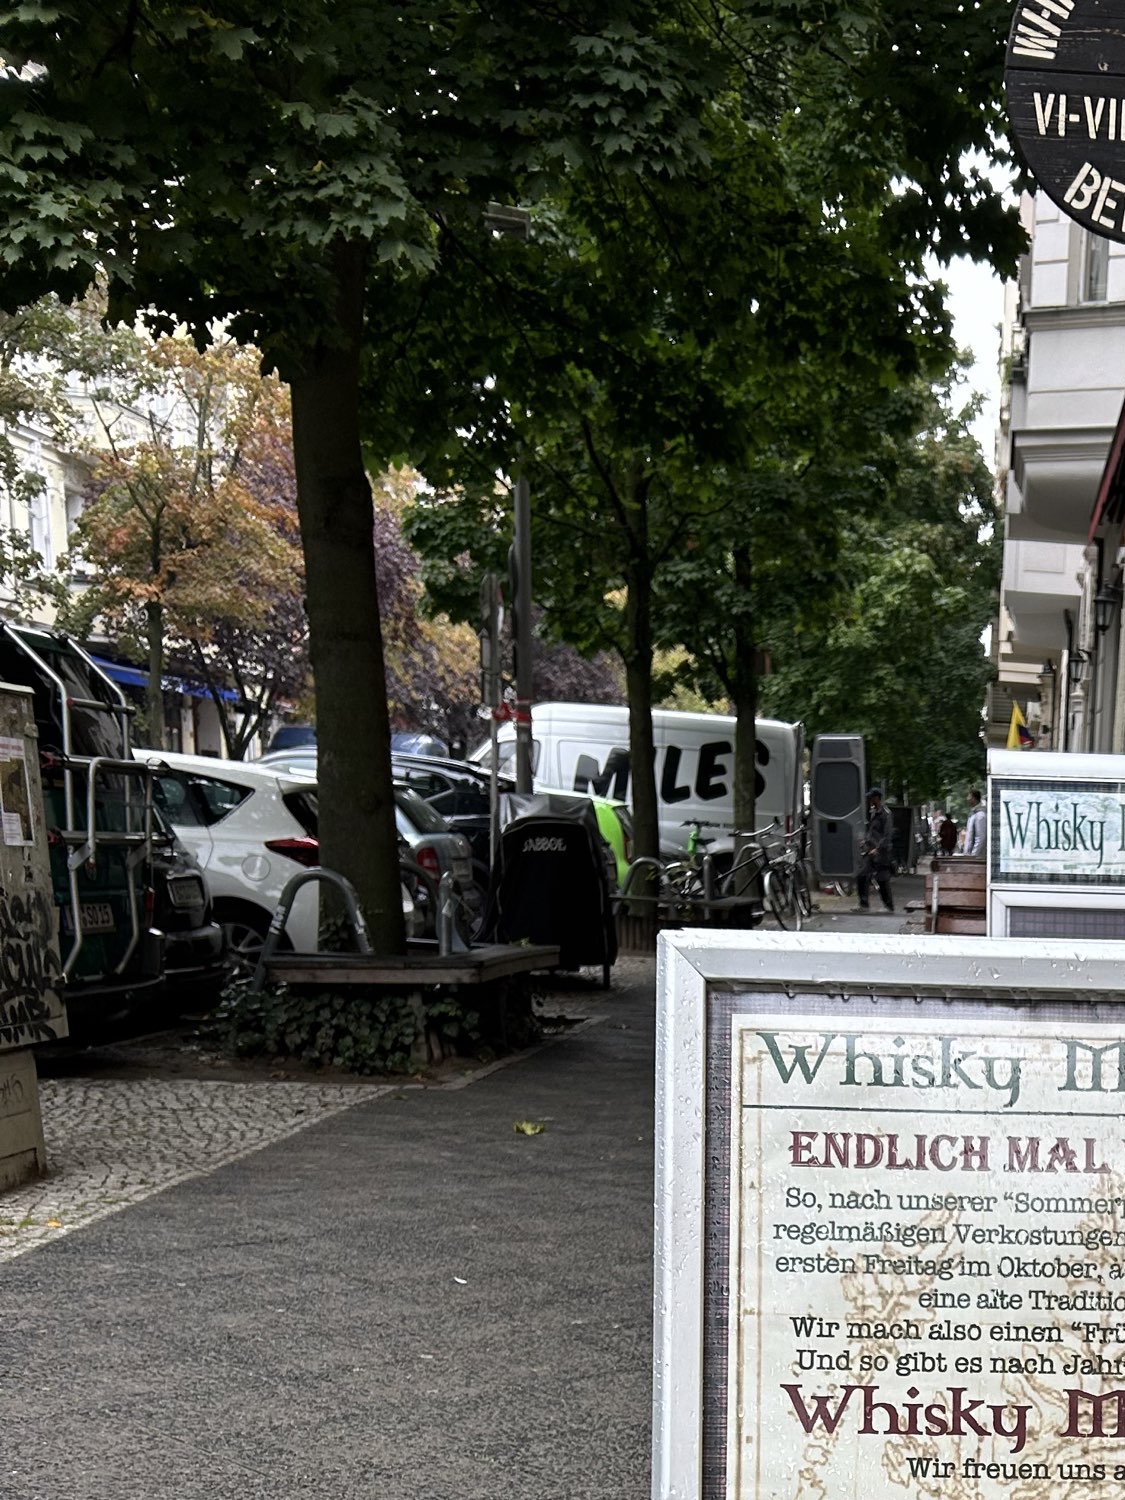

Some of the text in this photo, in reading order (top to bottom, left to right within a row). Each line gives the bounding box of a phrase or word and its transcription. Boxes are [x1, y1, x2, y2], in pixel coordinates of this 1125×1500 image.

[1013, 0, 1076, 59] WH
[1003, 801, 1106, 867] Whisky
[756, 1032, 1025, 1107] Whisky
[790, 1131, 991, 1171] ENDLICH
[1003, 1136, 1110, 1175] MAL
[785, 1187, 823, 1214] So,
[828, 1190, 892, 1210] nach
[898, 1194, 998, 1212] unserer
[773, 1221, 946, 1247] regelmäßigen
[775, 1254, 857, 1274] ersten
[862, 1254, 954, 1279] Freitag
[958, 1257, 992, 1277] im
[998, 1256, 1103, 1281] Oktober,
[918, 1288, 971, 1309] eine
[976, 1289, 1023, 1310] alte
[790, 1316, 841, 1338] Wir
[846, 1320, 923, 1340] mach
[928, 1320, 982, 1341] also
[989, 1321, 1064, 1342] einen
[796, 1349, 853, 1371] Und
[859, 1354, 889, 1372] so
[896, 1351, 948, 1376] gibt
[954, 1355, 983, 1373] es
[989, 1352, 1057, 1375] nach
[780, 1383, 1033, 1453] Whisky
[906, 1457, 955, 1478] Wir
[963, 1458, 1051, 1480] freuen
[1058, 1462, 1106, 1481] uns
